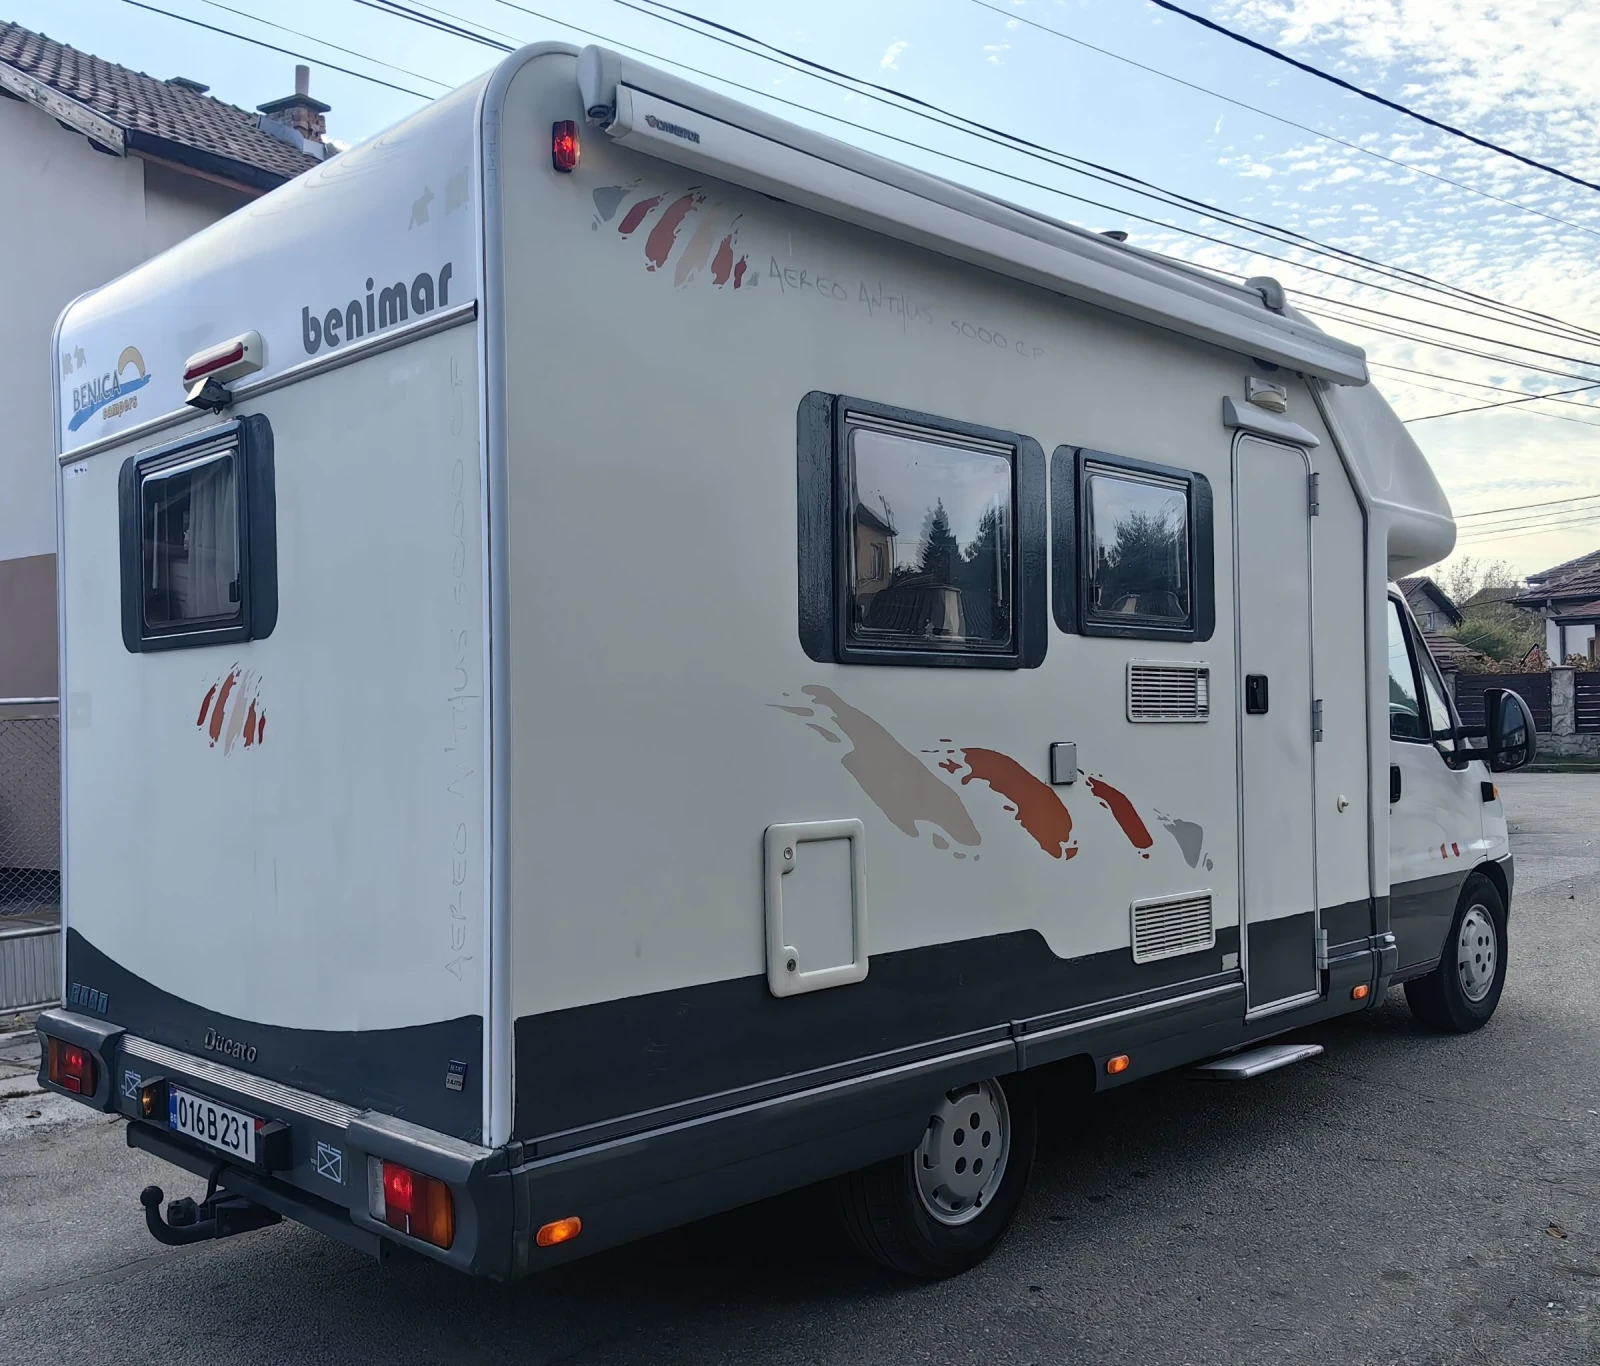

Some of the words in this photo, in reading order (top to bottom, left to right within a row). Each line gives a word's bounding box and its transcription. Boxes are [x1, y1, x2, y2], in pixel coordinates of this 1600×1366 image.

[768, 256, 847, 300] AEREO
[302, 262, 452, 354] benimar
[73, 370, 121, 412] BENICA
[102, 395, 138, 420] campers
[204, 1026, 257, 1063] Ducato
[178, 1096, 249, 1155] 016B231
